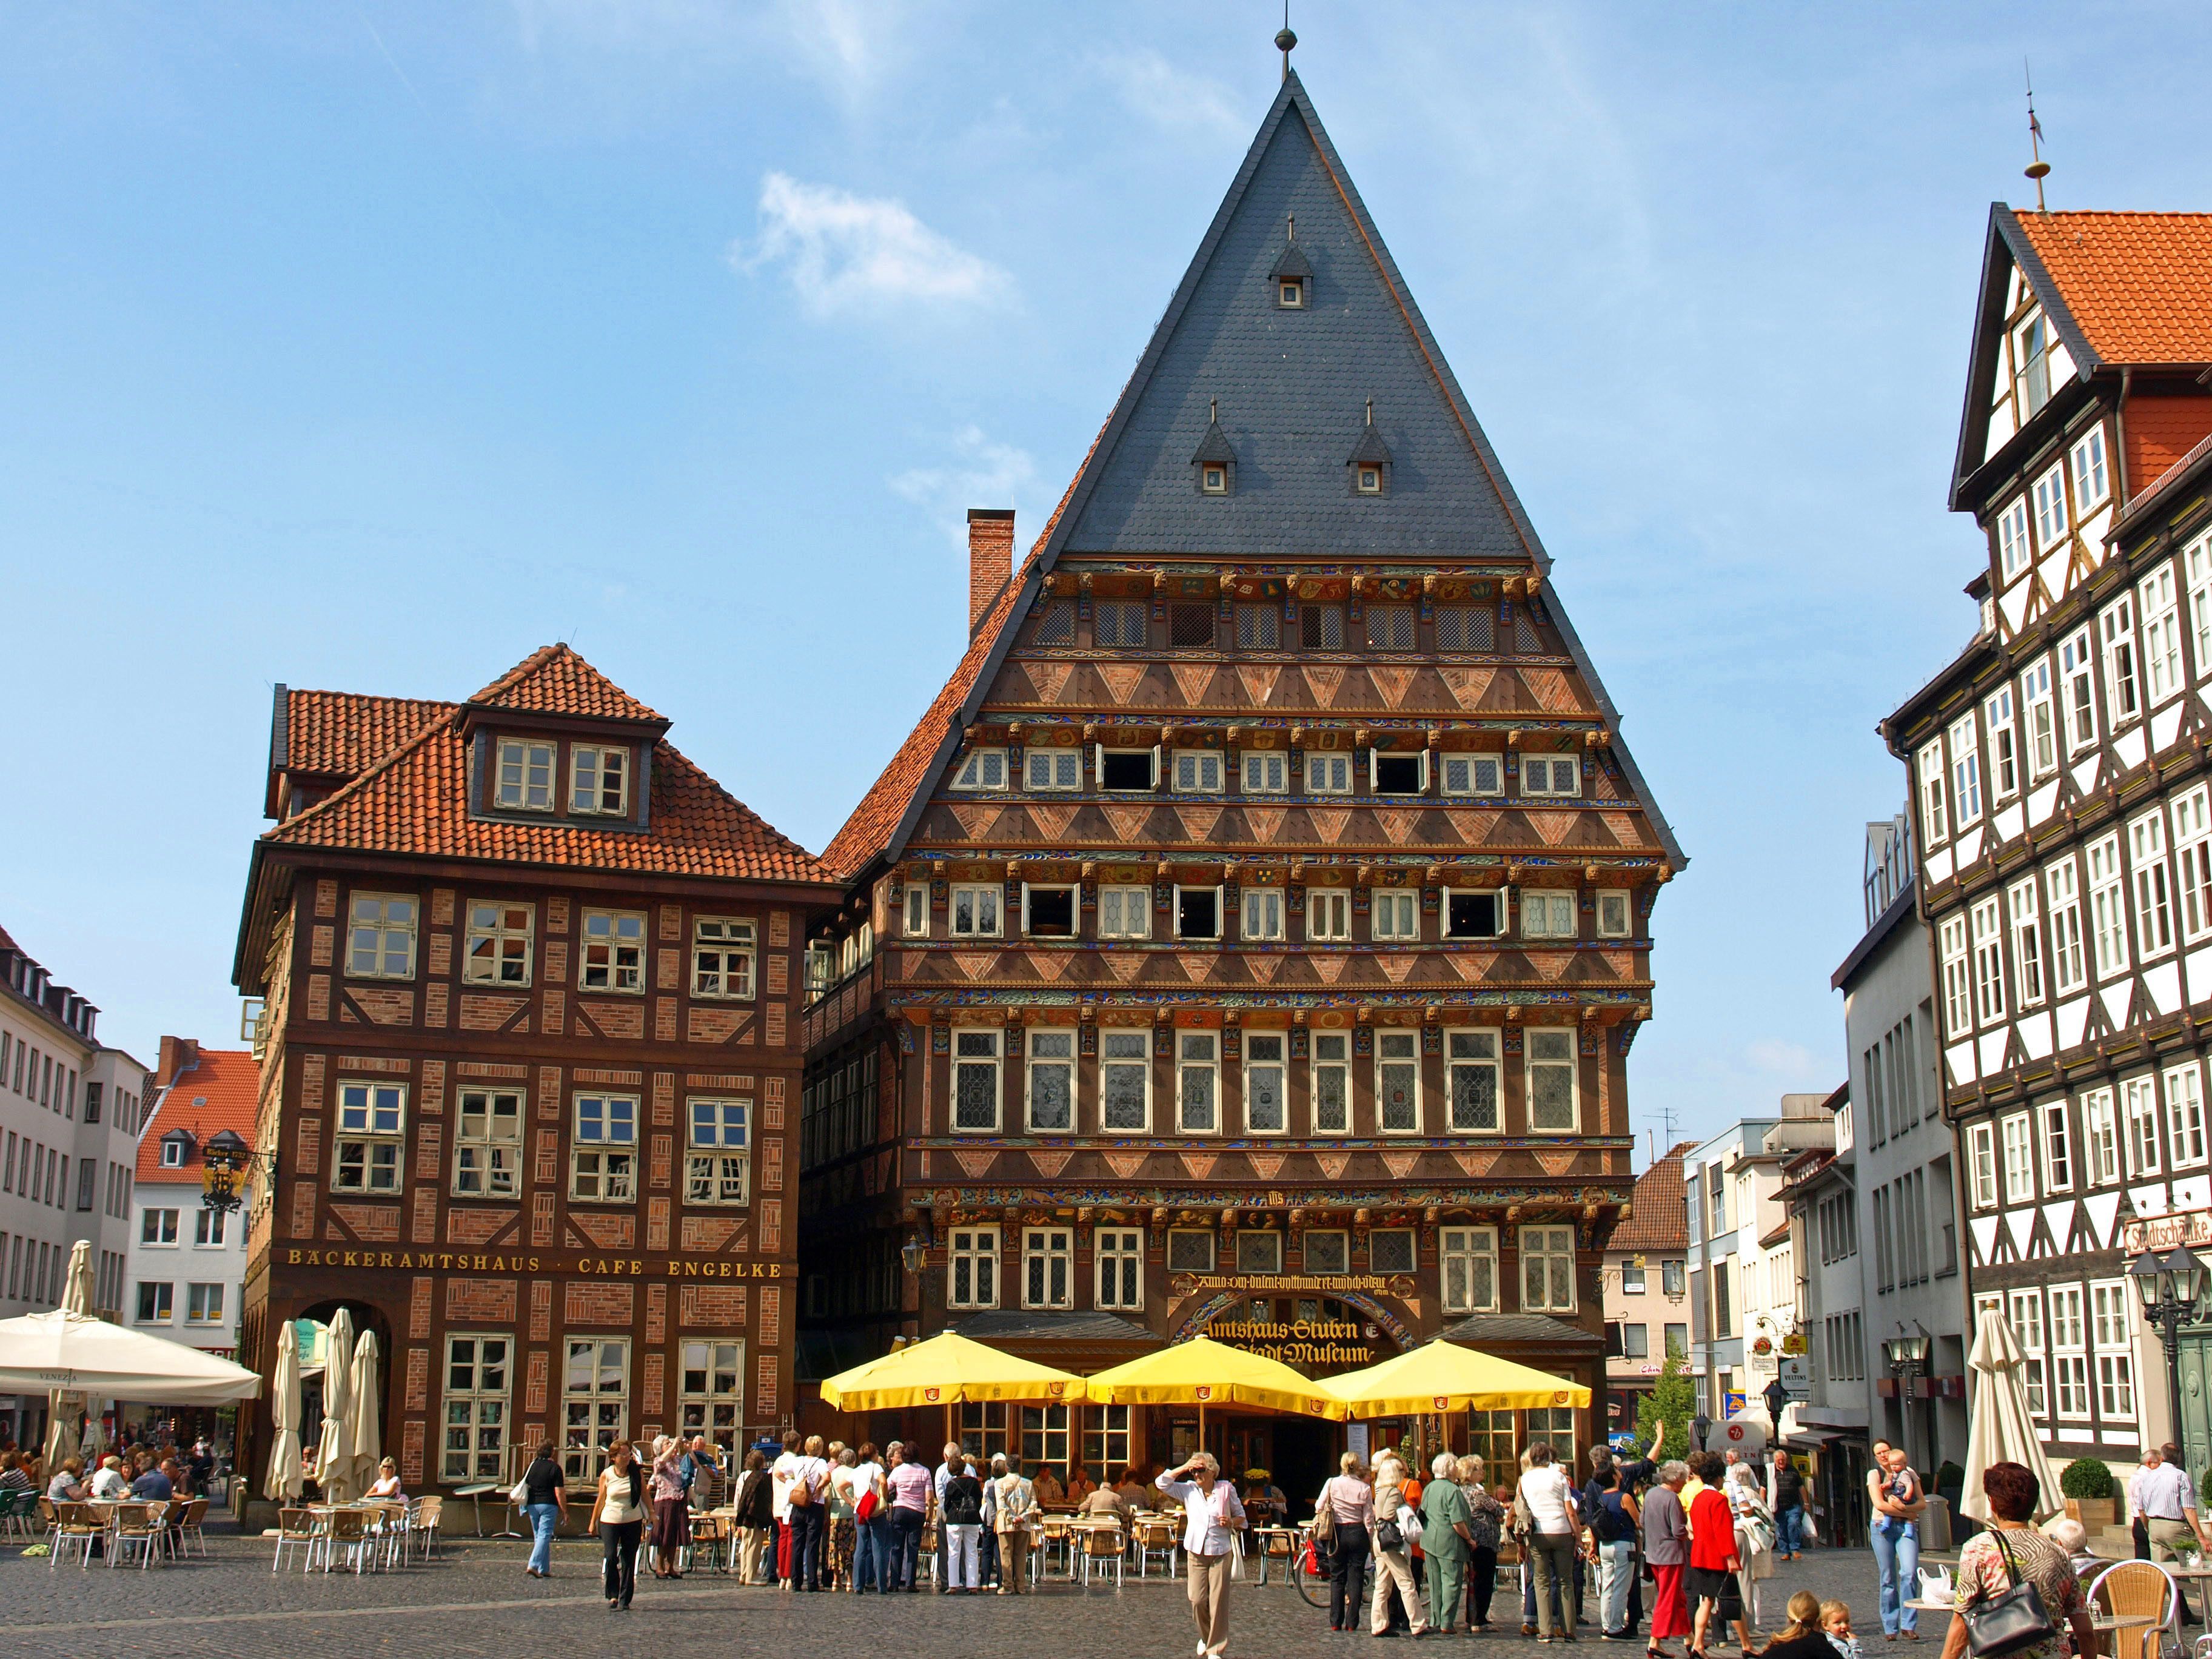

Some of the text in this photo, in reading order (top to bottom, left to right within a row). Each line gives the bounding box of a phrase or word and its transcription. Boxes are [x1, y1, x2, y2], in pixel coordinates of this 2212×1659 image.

[2132, 1215, 2208, 1250] Stadtschänke
[287, 1249, 780, 1278] BÄCKERAMTSHAUS CAFE ENGELKE
